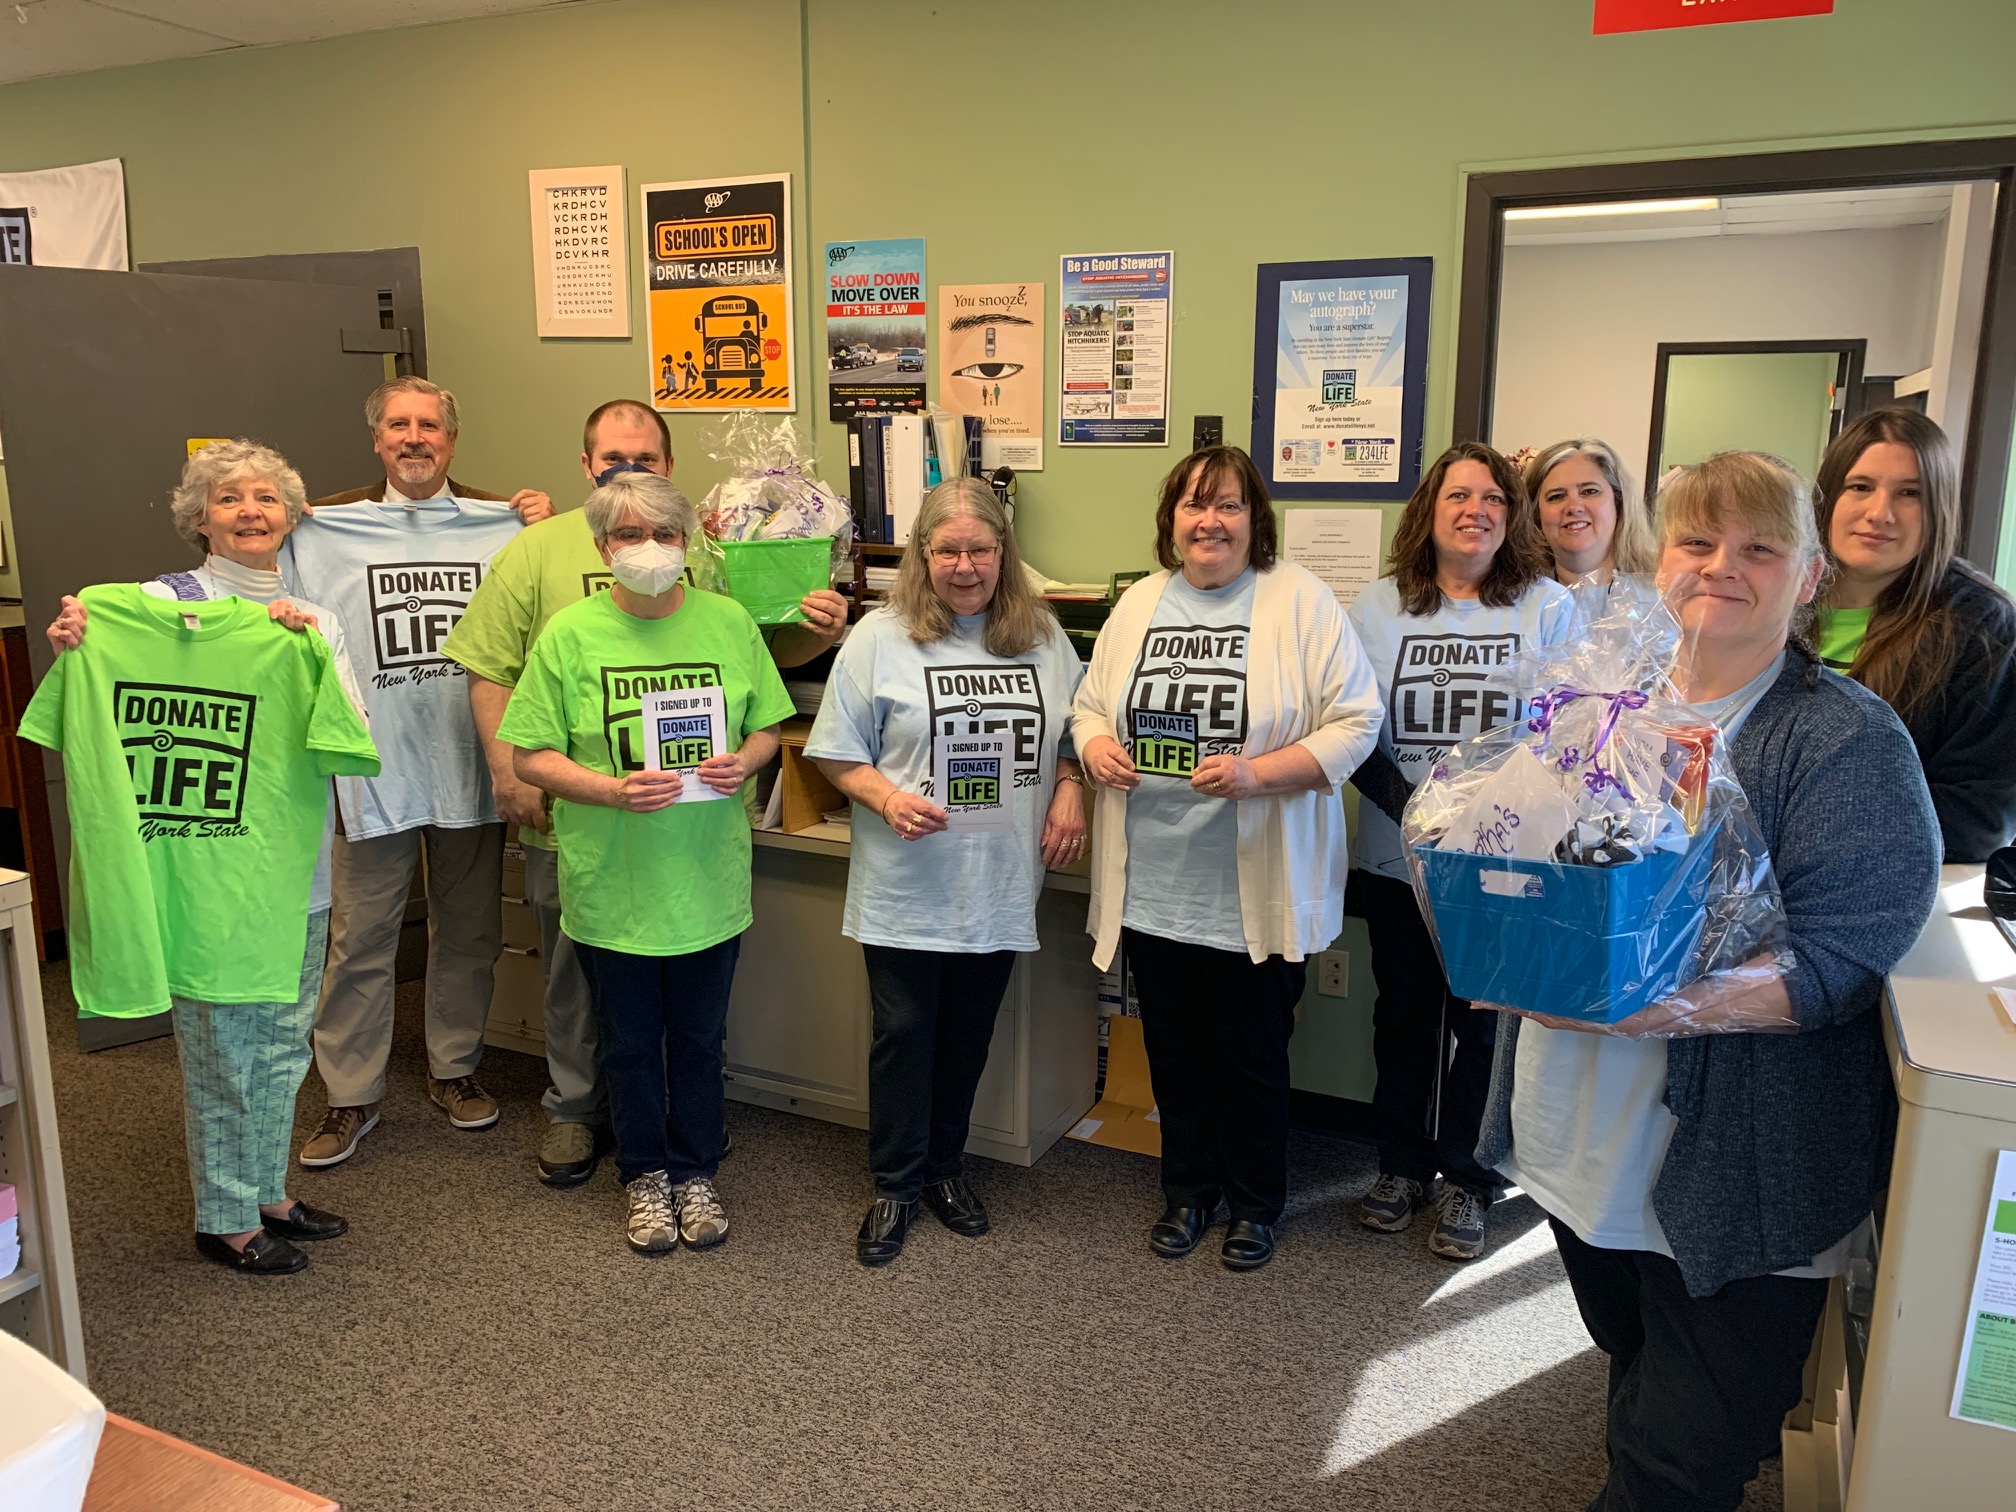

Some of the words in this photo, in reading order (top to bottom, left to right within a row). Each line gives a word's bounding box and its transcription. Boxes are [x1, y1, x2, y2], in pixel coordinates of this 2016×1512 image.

[664, 227, 728, 251] SCHOOL'S
[732, 224, 767, 247] OPEN
[656, 264, 696, 281] DRIVE
[700, 259, 777, 279] CAREFULLY
[1067, 260, 1081, 273] Be
[1083, 261, 1090, 272] a
[1092, 258, 1119, 272] Good
[1121, 256, 1166, 270] Steward
[830, 274, 870, 288] SLOW
[874, 272, 920, 287] DOWN
[832, 288, 875, 303] MOVE
[880, 287, 920, 301] OVER
[954, 295, 975, 308] You
[1291, 290, 1315, 307] May
[1318, 291, 1335, 302] we
[1338, 287, 1366, 302] have
[1368, 289, 1398, 304] your
[843, 305, 860, 316] IT'S
[863, 305, 882, 315] THE
[885, 304, 908, 314] LAW
[1310, 302, 1377, 320] autograph?
[1309, 324, 1322, 332] You
[1342, 324, 1374, 332] superstar.
[1067, 337, 1110, 345] HITCHHIKERS!
[765, 346, 780, 355] STOP
[1326, 372, 1353, 380] DONATE
[1326, 387, 1352, 400] LIFE
[1307, 404, 1325, 412] New
[1328, 402, 1348, 412] York
[1351, 399, 1372, 407] State
[1360, 446, 1389, 460] 234LFE
[379, 572, 472, 595] DONATE
[1150, 636, 1245, 660] DONATE
[1410, 644, 1510, 666] DONATE
[372, 673, 407, 690] New
[409, 662, 449, 685] York
[937, 674, 1032, 696] DONATE
[655, 702, 658, 711] I
[660, 700, 688, 711] SIGNED
[690, 699, 700, 709] UP
[702, 697, 712, 707] TO
[1404, 690, 1509, 734] LIFE
[125, 696, 242, 733] DONATE
[663, 720, 708, 734] DONATE
[1139, 715, 1193, 732] DONATE
[665, 742, 709, 765] LIFE
[947, 744, 950, 753] I
[952, 743, 979, 753] SIGNED
[981, 743, 991, 752] UP
[994, 742, 1003, 752] TO
[1140, 742, 1192, 772] LIFE
[676, 768, 695, 778] York
[953, 762, 996, 773] DONATE
[954, 782, 995, 800] LIFE
[944, 806, 961, 814] New
[962, 805, 981, 813] York
[983, 802, 1003, 810] State
[138, 820, 192, 844] York
[196, 819, 250, 838] State
[1980, 1314, 2009, 1323] ABOUT
